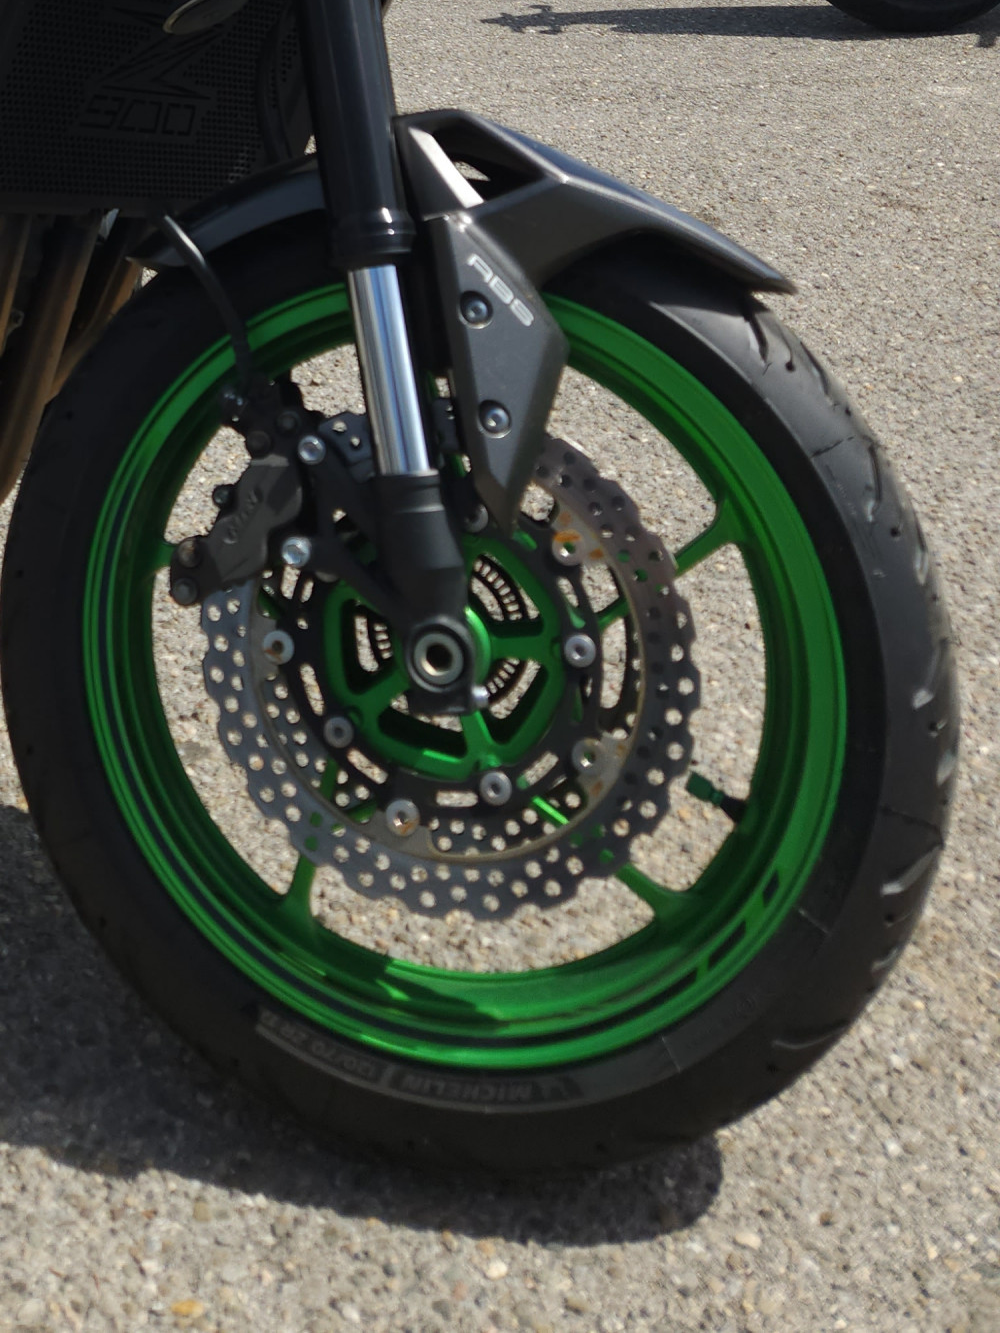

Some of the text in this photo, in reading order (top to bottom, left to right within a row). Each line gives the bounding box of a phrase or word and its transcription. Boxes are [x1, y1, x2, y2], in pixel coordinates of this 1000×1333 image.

[79, 94, 196, 137] 900
[467, 253, 534, 327] ABS
[401, 1075, 532, 1101] MICHELIN
